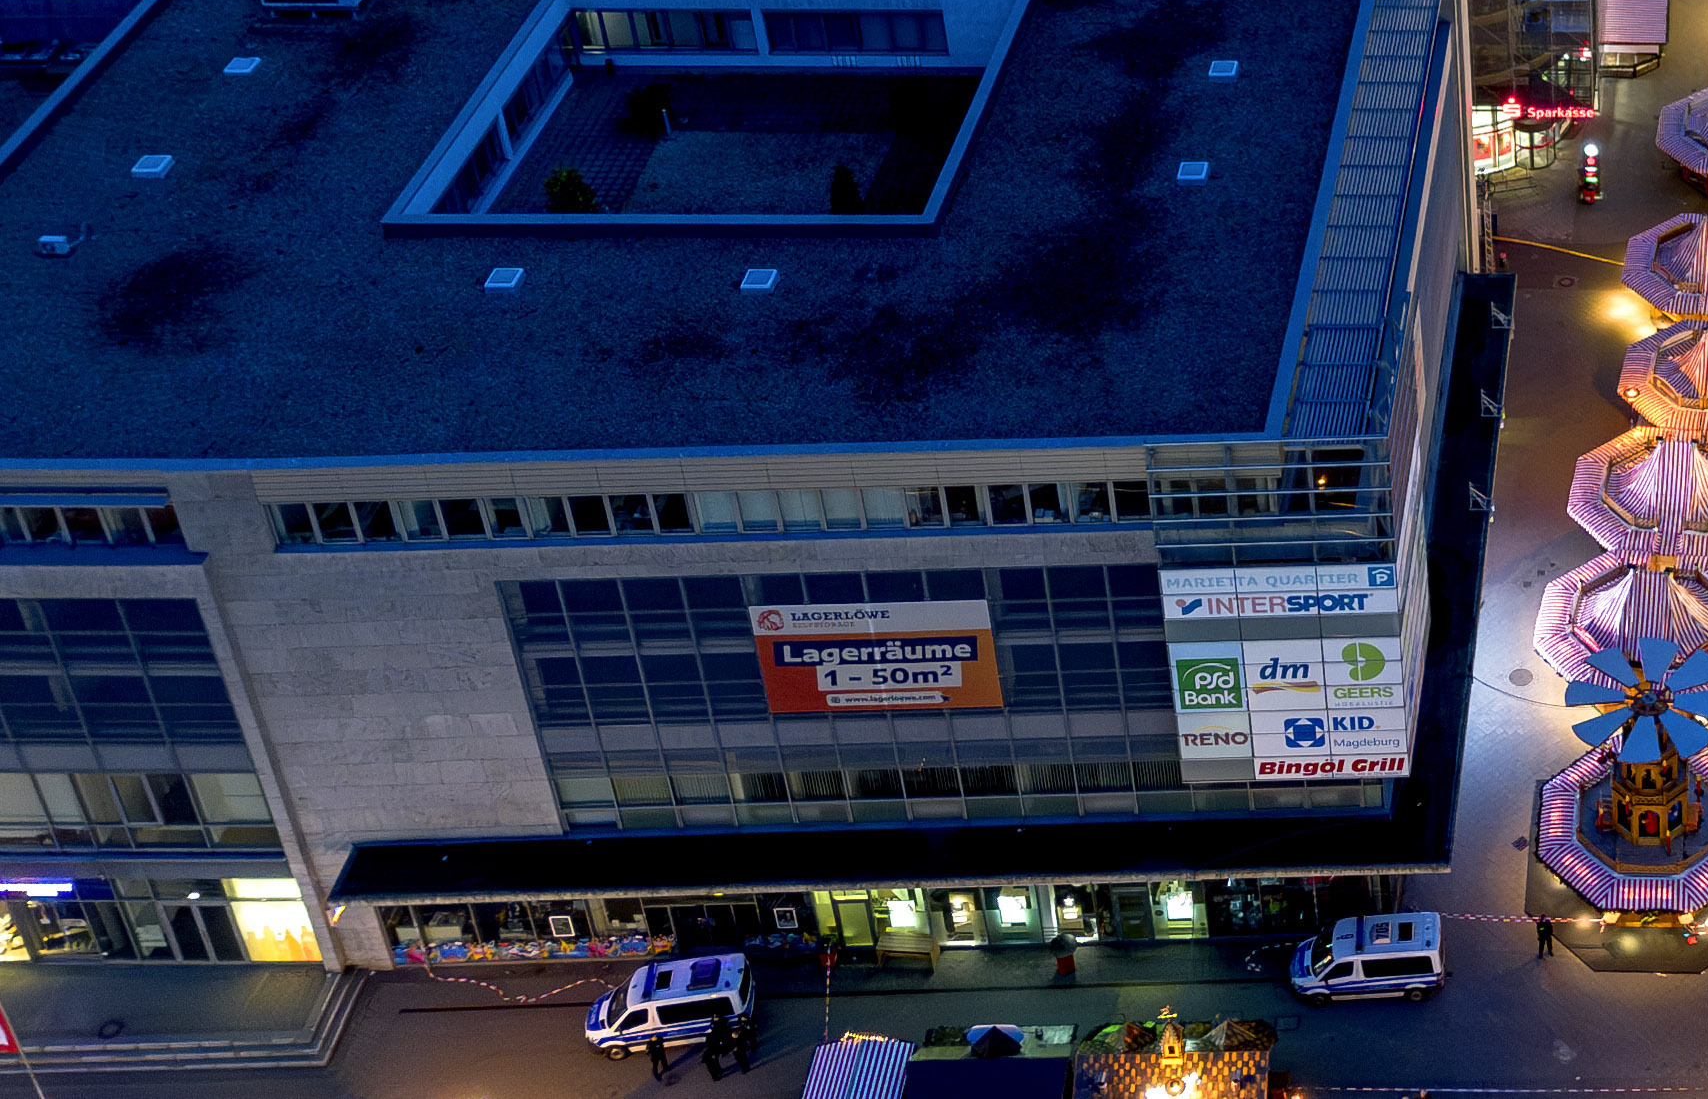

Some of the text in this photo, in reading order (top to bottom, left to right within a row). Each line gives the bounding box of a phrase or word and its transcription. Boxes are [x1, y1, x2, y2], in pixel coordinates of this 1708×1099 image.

[1527, 106, 1595, 120] Sparkasse
[1166, 573, 1359, 588] MARIETTA QUARTIER
[1207, 594, 1368, 615] INTERSPORT
[790, 609, 890, 621] LAGERLÖWE
[783, 641, 972, 665] Lagerräume
[1259, 657, 1309, 680] dm
[824, 670, 838, 686] 1
[1184, 690, 1237, 705] Bank
[1333, 686, 1394, 699] GEERS
[1332, 716, 1375, 731] KID
[1182, 732, 1248, 747] RENO
[1333, 737, 1400, 749] Magdeburg
[1351, 757, 1405, 773] Grill
